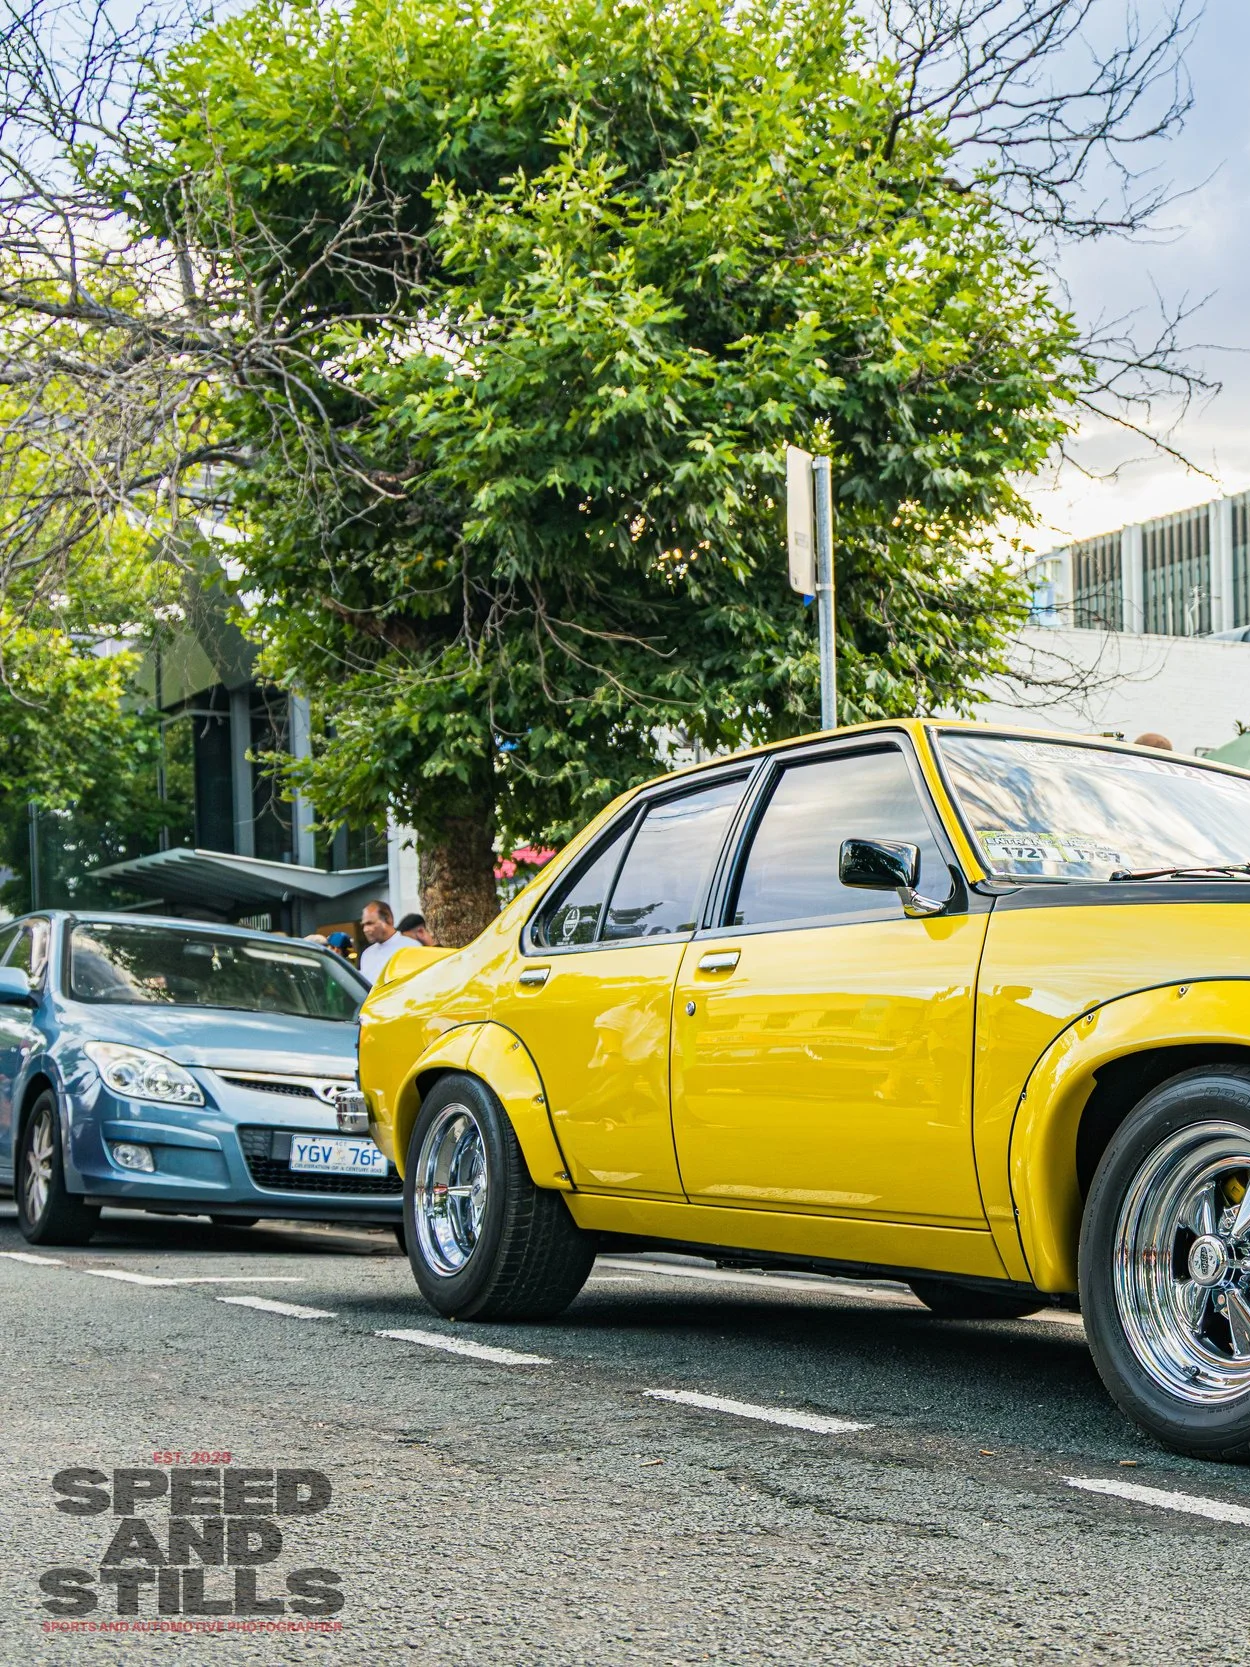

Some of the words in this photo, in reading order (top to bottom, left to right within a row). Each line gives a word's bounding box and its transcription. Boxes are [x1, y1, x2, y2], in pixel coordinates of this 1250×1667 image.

[1001, 846, 1049, 859] 1721
[297, 1144, 333, 1163] YGV
[348, 1147, 383, 1166] 76P
